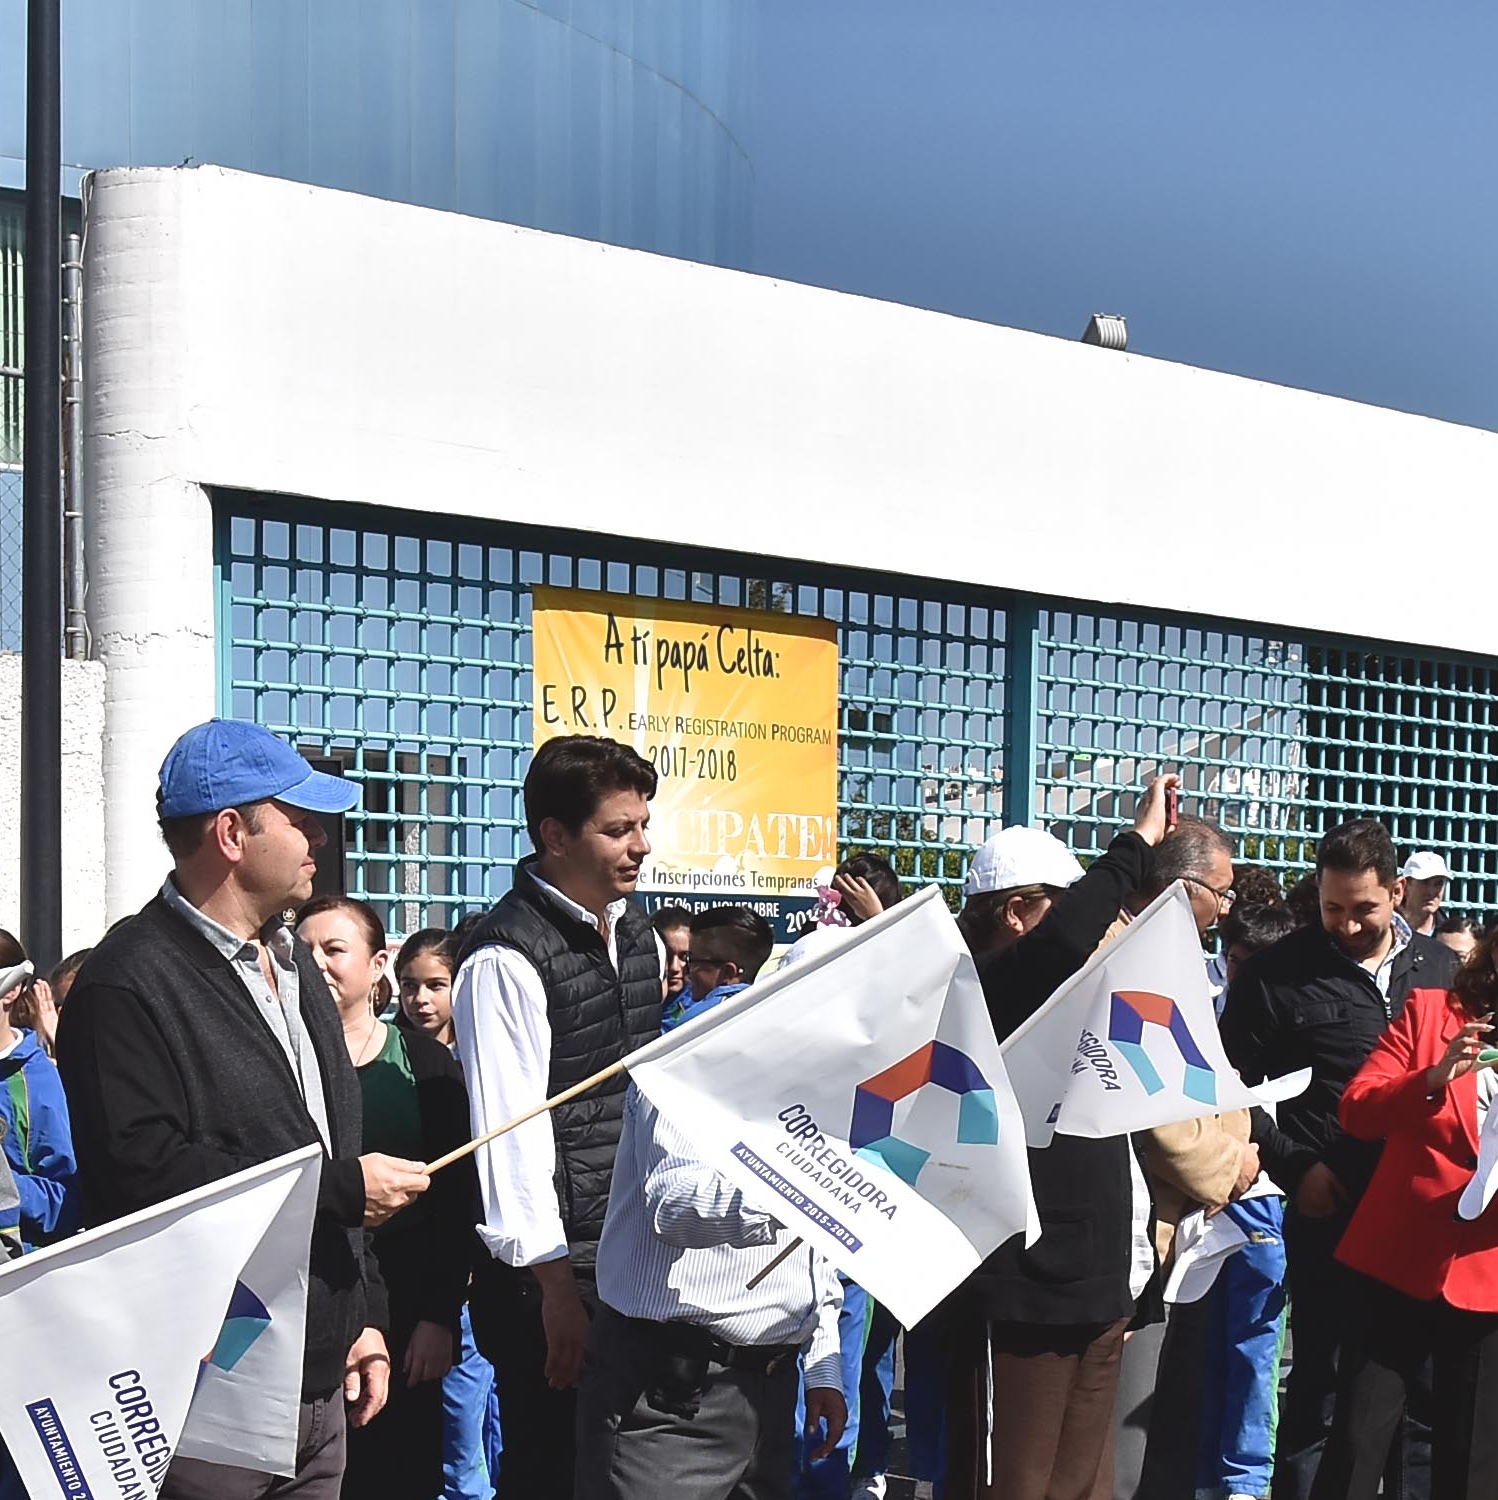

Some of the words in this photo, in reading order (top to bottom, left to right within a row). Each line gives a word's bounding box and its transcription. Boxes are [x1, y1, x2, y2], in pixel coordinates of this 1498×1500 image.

[604, 611, 624, 666] A
[657, 632, 709, 692] papá
[716, 624, 781, 679] Celta:
[628, 712, 671, 733] EARLY
[675, 716, 767, 741] REGISTRATION
[771, 724, 833, 745] PROGRAM
[648, 745, 737, 782] 2017-2018
[652, 867, 747, 890] Inscripciones
[750, 870, 819, 893] Tempranas
[694, 901, 709, 916] EN
[736, 1147, 803, 1207] AYUNTAMIENTO
[802, 1201, 856, 1247] 2015-2018
[775, 1141, 862, 1214] CIUDADANA
[777, 1103, 898, 1221] CORREGIDORA
[33, 1405, 82, 1492] AYUNTAMIENTO
[108, 1370, 173, 1493] CORREGID
